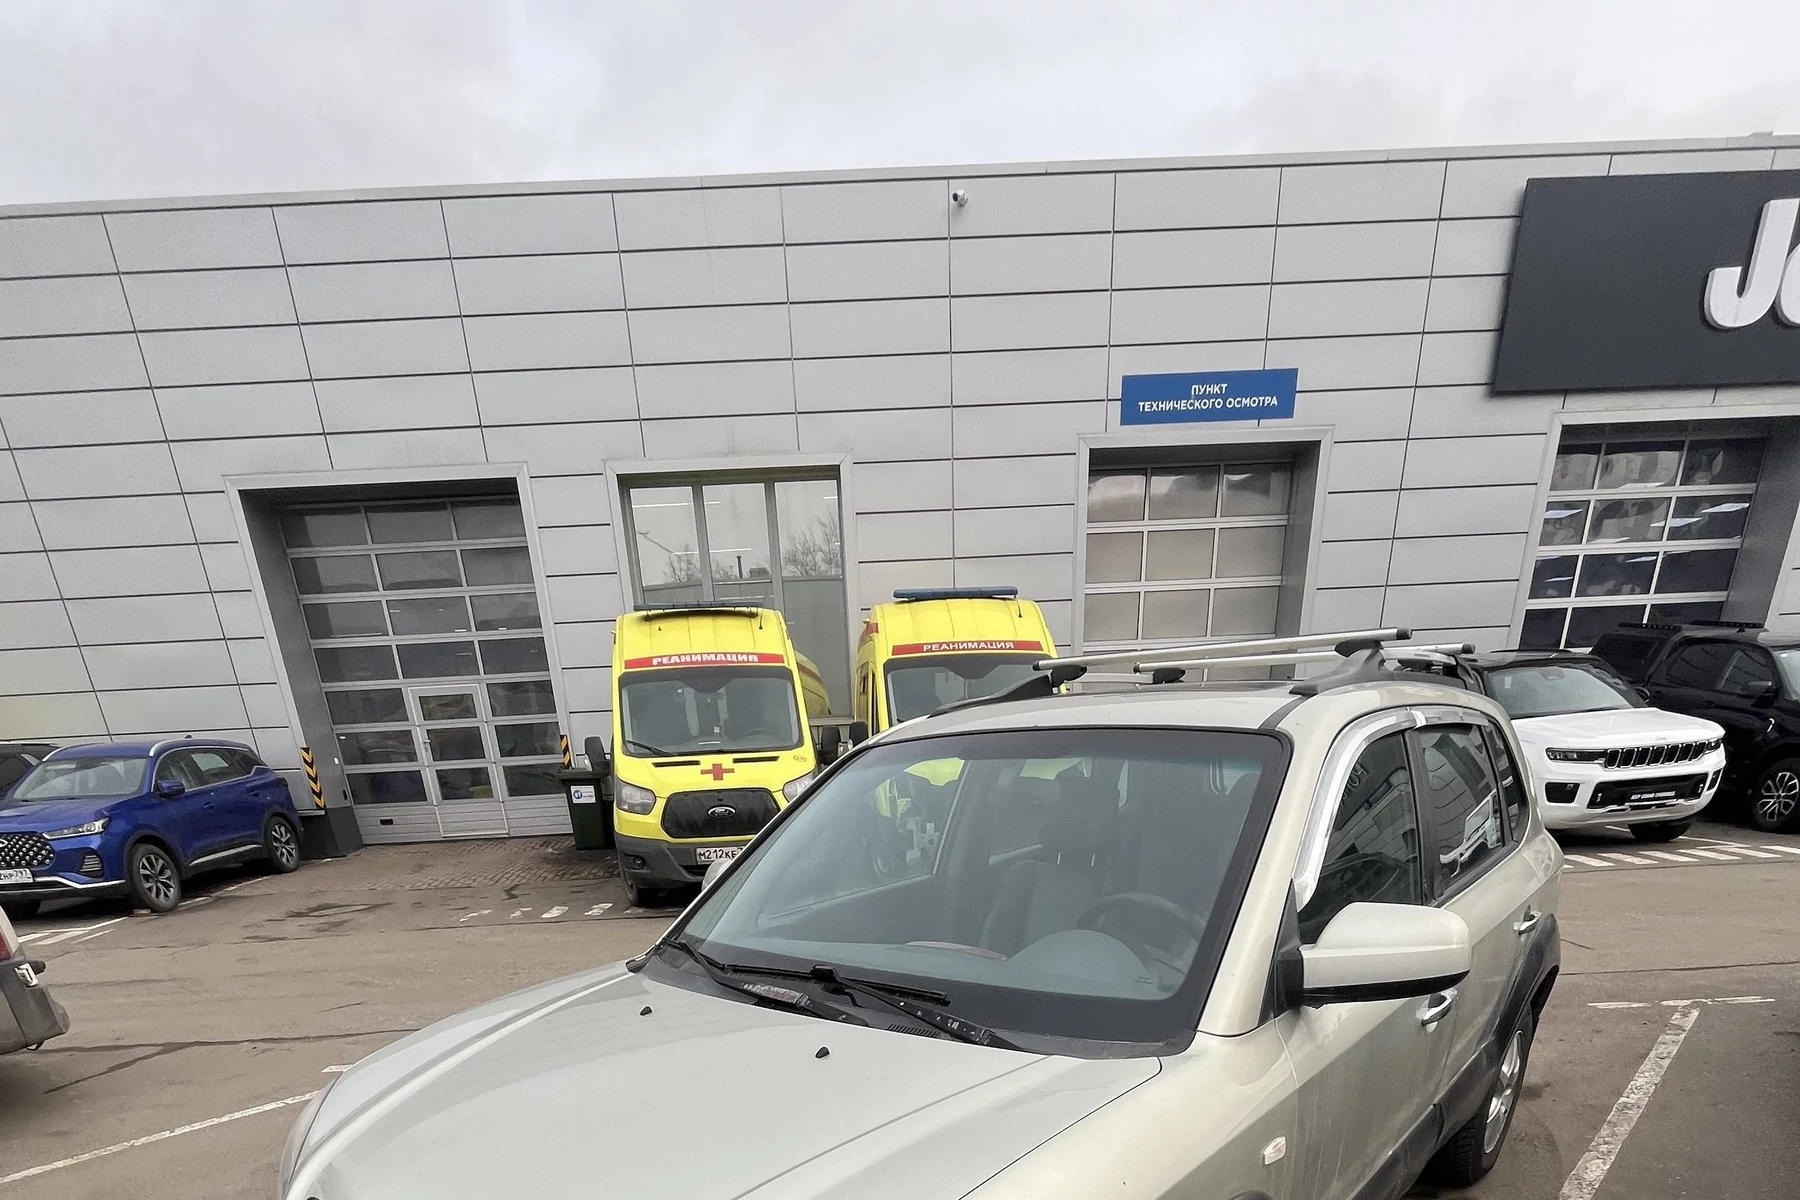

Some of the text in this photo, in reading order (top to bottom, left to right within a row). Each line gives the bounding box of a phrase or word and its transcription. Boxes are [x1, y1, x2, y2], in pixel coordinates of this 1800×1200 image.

[1191, 383, 1228, 396] ПУНКТ
[1138, 395, 1278, 412] ТЕХНИЧЕСКОГО ОСМОТРА
[923, 641, 1014, 652] РЕАНИМАЦИЯ
[652, 653, 758, 666] РЕАНИМАЦИЯ
